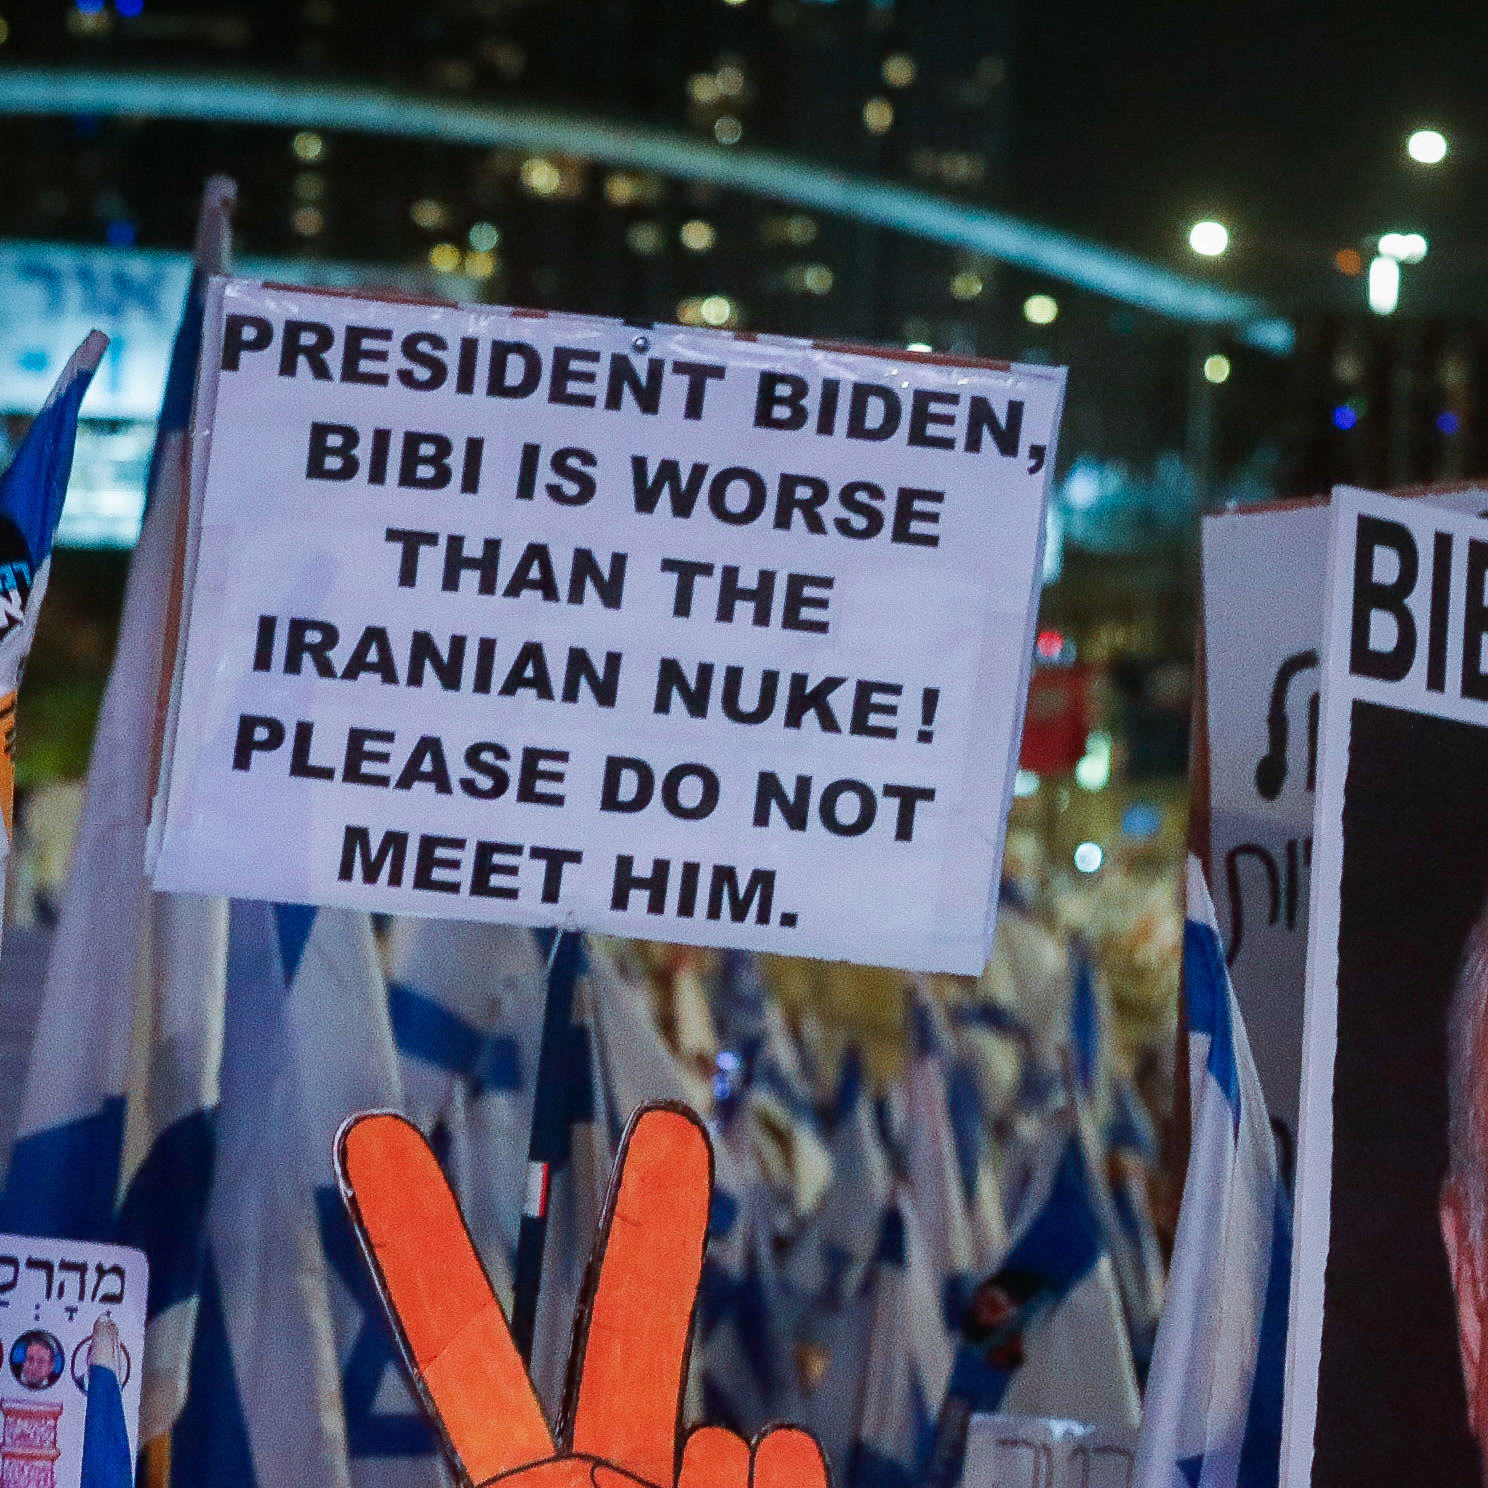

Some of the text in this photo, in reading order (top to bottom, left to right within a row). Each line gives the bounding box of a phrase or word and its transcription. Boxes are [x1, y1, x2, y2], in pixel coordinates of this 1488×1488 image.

[220, 314, 1047, 475] PRESIDENT BIDEN,
[305, 422, 946, 548] BIBI IS WORSE
[384, 528, 835, 634] THAN THE
[252, 615, 940, 744] IRANIAN NUKE!
[231, 714, 936, 843] PLEASE DO NOT
[337, 825, 799, 928] MEET HIM.
